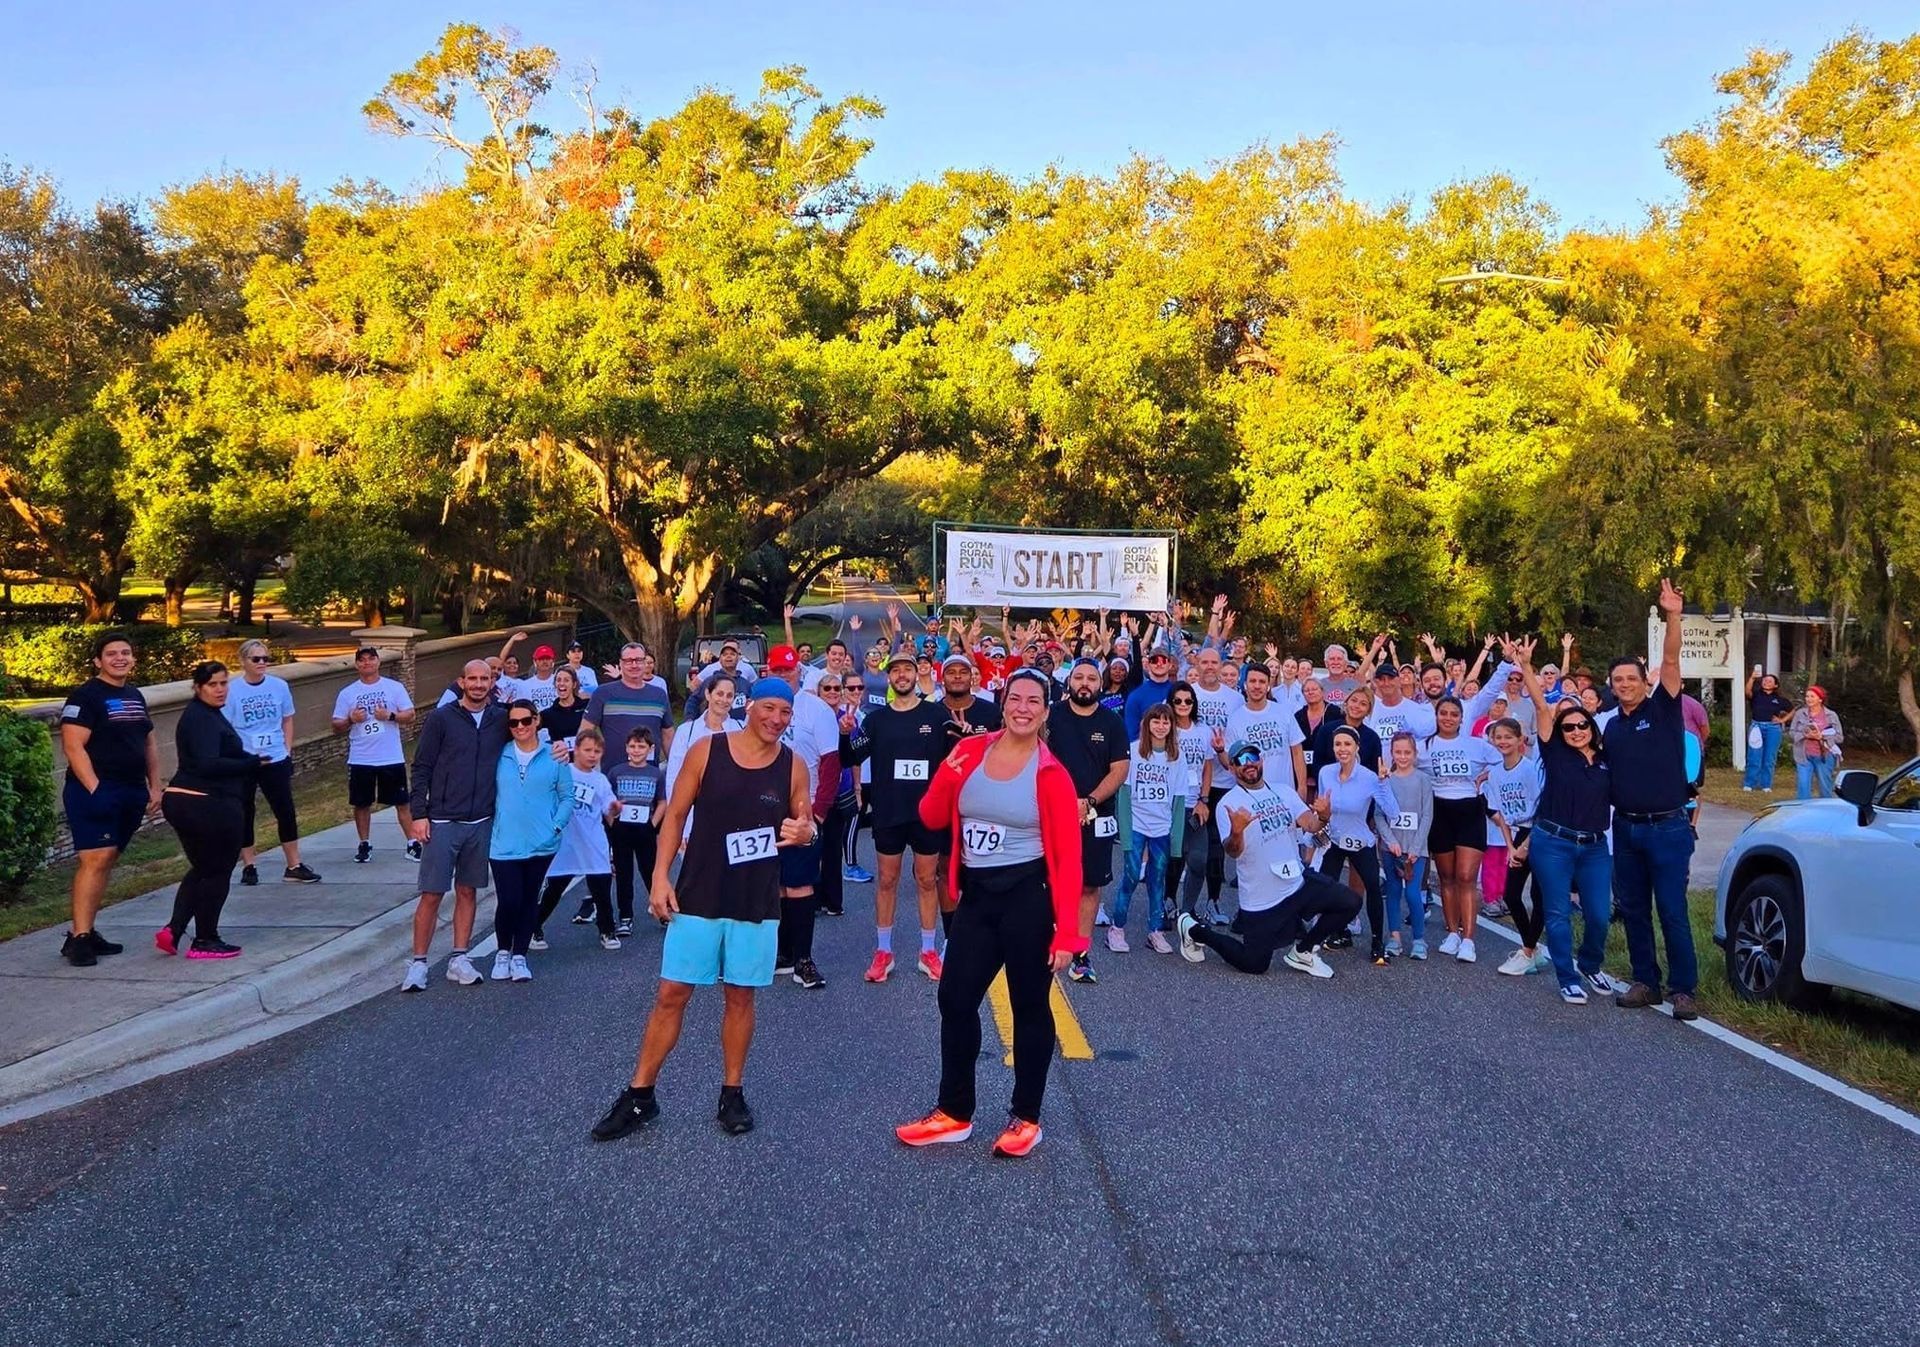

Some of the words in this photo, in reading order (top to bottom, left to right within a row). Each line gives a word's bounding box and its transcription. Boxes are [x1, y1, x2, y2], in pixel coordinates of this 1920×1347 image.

[959, 541, 994, 549] GOTHA
[1123, 546, 1159, 554] GOTHA
[959, 549, 995, 558] RURAL
[1123, 554, 1159, 562] RURAL
[959, 557, 994, 570] RUN
[1013, 549, 1104, 591] START
[1123, 562, 1158, 575] RUN
[1682, 628, 1710, 637] GOTHA
[1682, 640, 1720, 648] MMUNITY
[1681, 650, 1713, 659] CENTER
[240, 692, 273, 705] GOTHA
[242, 700, 277, 712] RURAL
[244, 707, 278, 723] RUN
[364, 722, 380, 735] 95
[1245, 721, 1278, 734] GOTHA
[1379, 726, 1394, 737] 70
[257, 735, 273, 746] 71
[901, 763, 922, 778] 16
[1442, 762, 1469, 774] 169
[1139, 787, 1166, 801] 139
[629, 808, 639, 820] 3
[731, 833, 772, 859] 137
[965, 828, 1001, 851] 179
[1344, 837, 1363, 850] 93
[1281, 863, 1291, 877] 4
